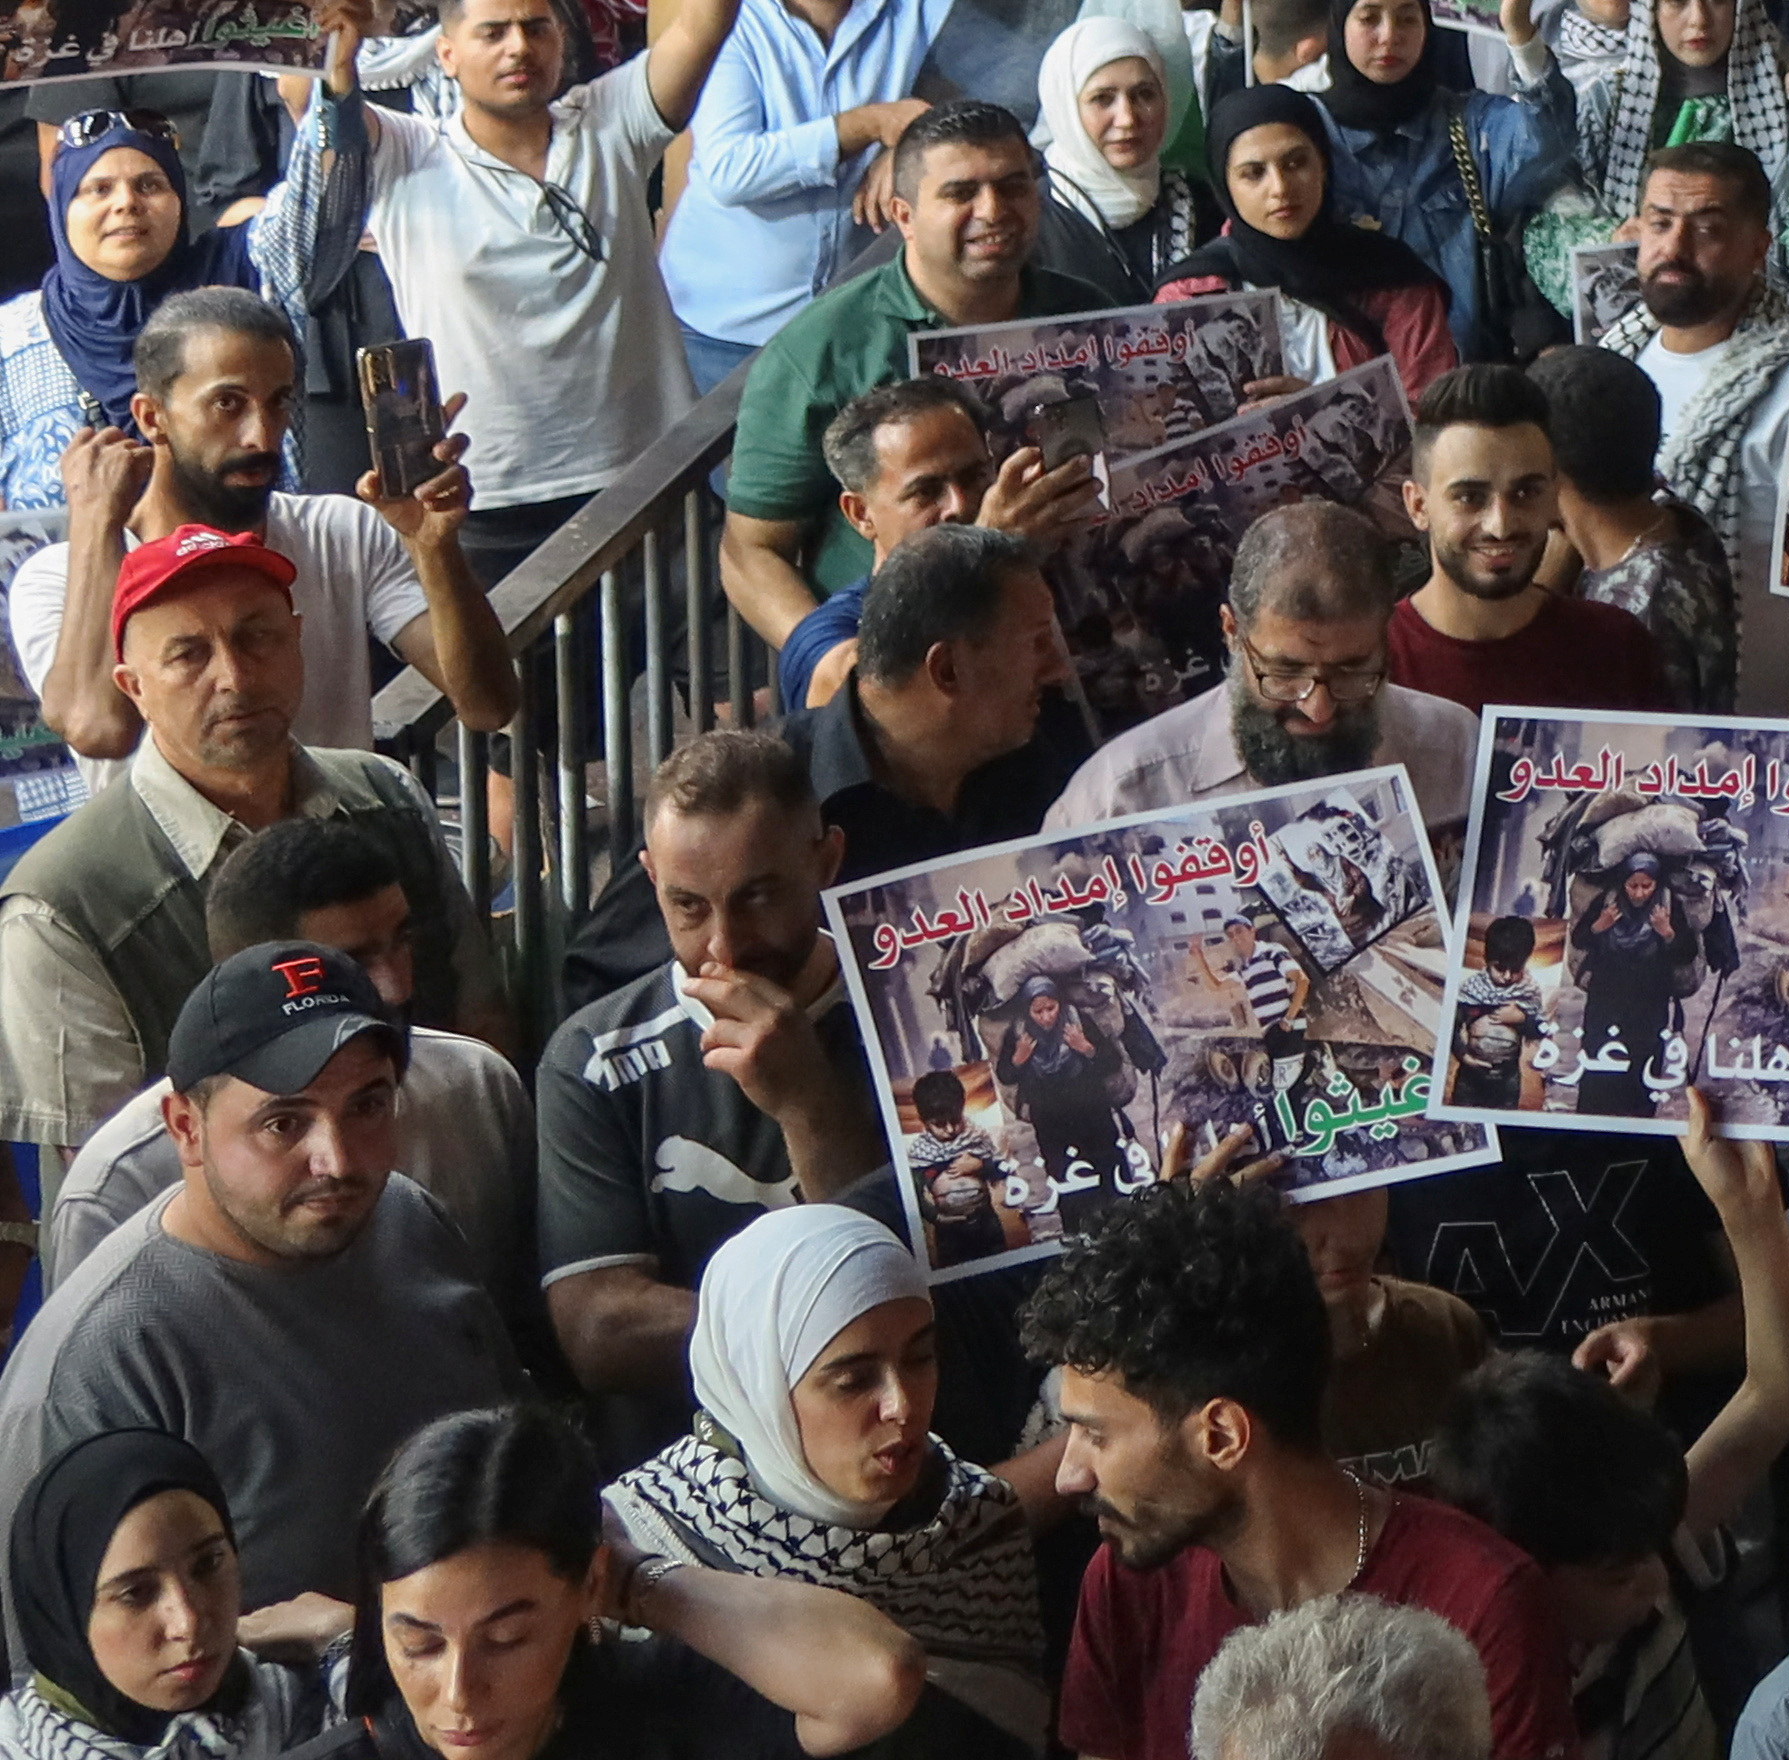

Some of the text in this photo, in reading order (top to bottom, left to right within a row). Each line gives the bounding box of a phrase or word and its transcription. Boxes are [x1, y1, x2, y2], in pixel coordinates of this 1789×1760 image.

[1020, 319, 1198, 375] أوقفوا إمداد
[1496, 743, 1624, 801] العدو
[1637, 753, 1756, 811] إمداد
[866, 820, 1272, 971] أوقفوا إمداد العدو
[270, 955, 326, 999] F
[1533, 1019, 1631, 1086] غزة
[1641, 1028, 1689, 1102] في
[1001, 1144, 1103, 1214] غزة
